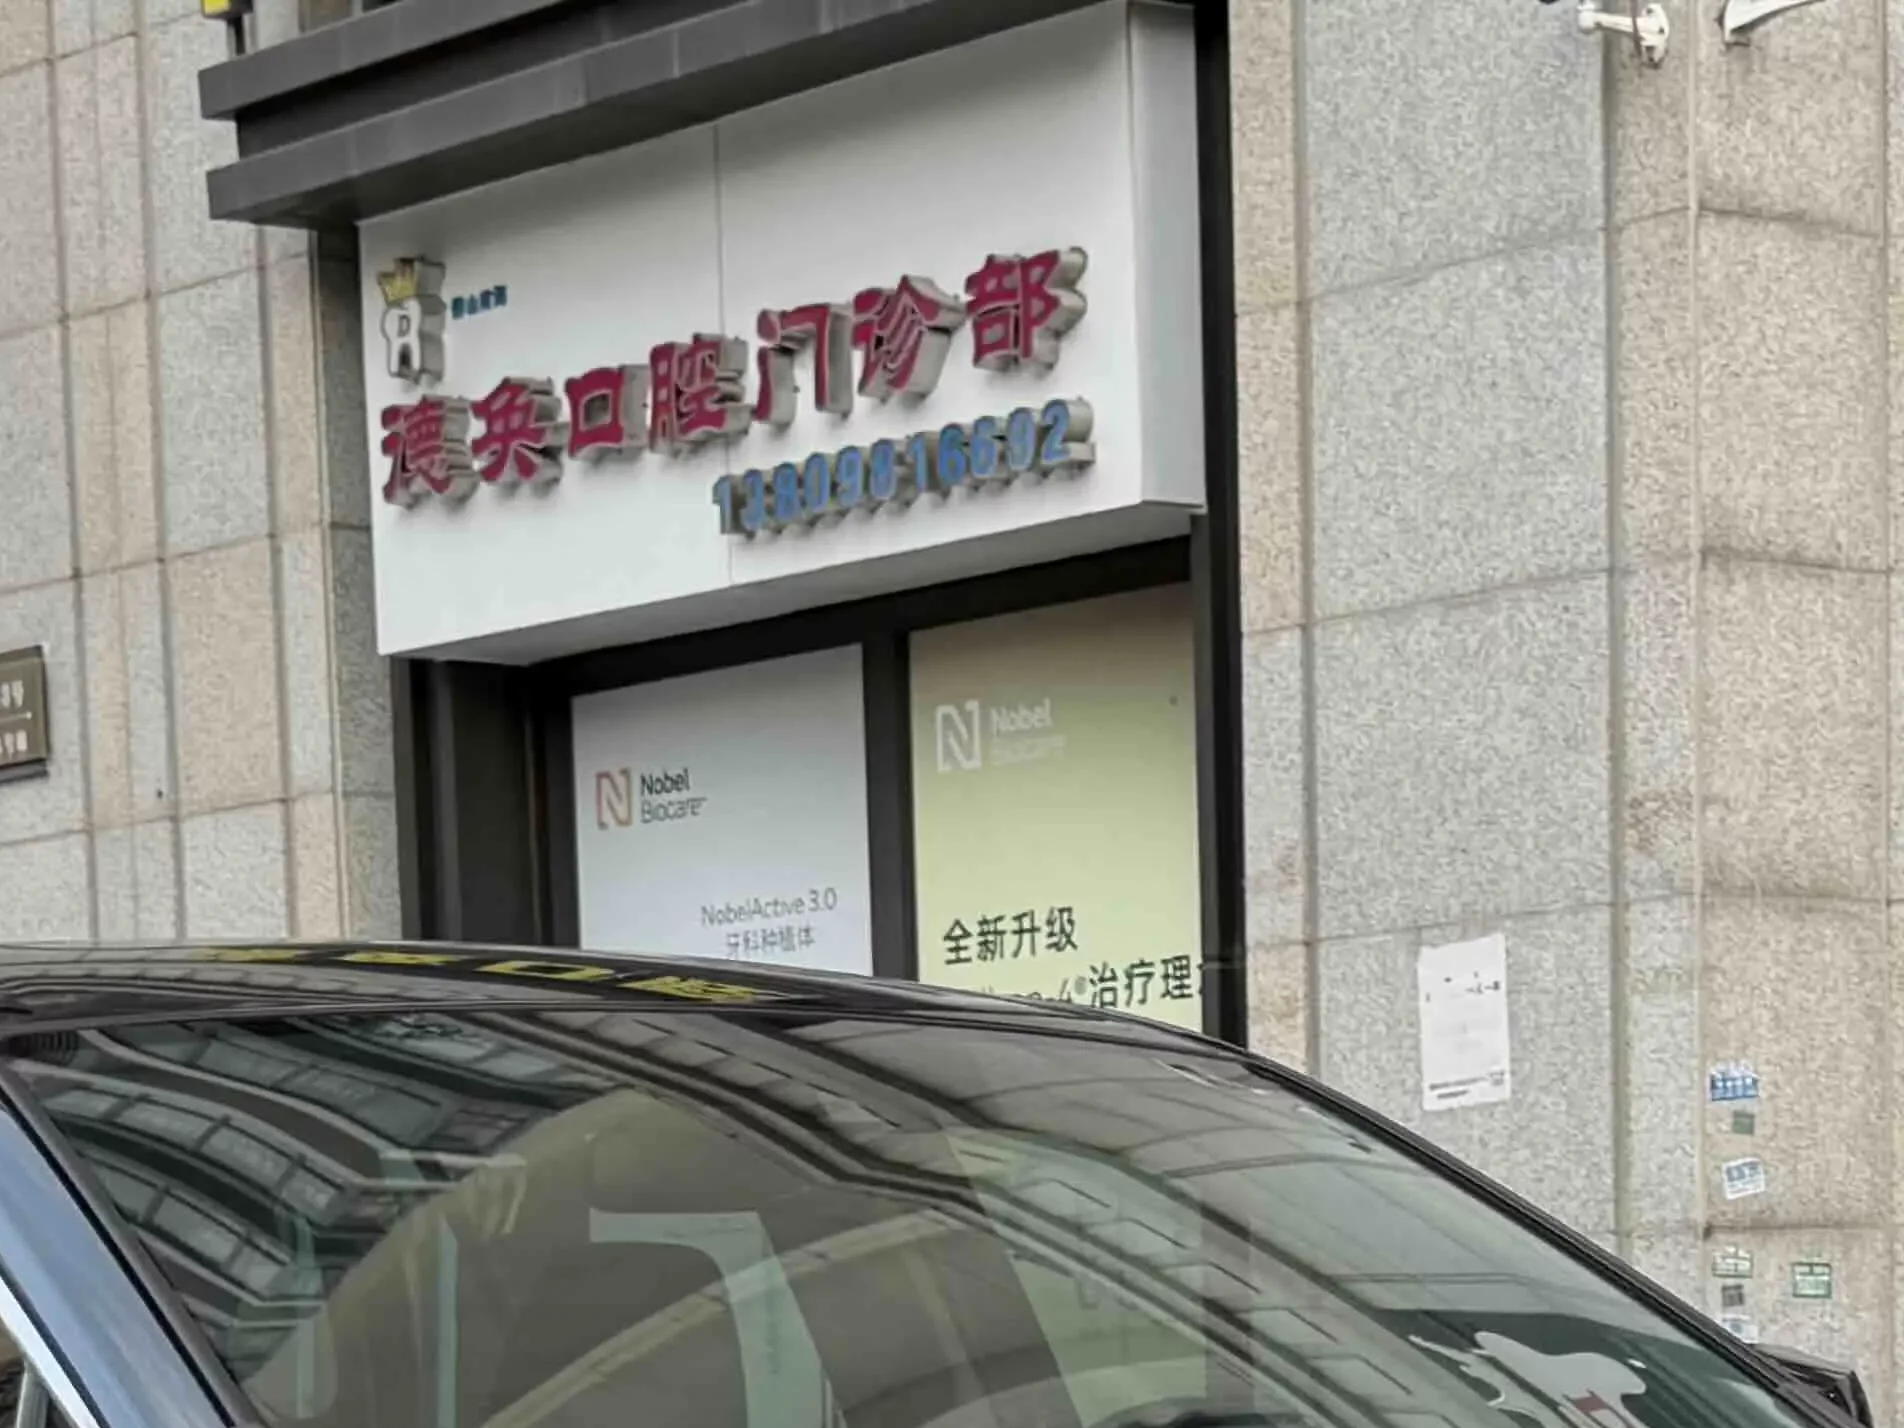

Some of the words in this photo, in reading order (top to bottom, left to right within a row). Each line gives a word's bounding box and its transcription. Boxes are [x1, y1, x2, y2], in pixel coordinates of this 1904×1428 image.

[991, 697, 1052, 737] Nobel
[640, 767, 690, 796] Nobel
[701, 896, 805, 928] NobelActive
[808, 887, 838, 914] 3.0
[943, 905, 1078, 966] 全新升级
